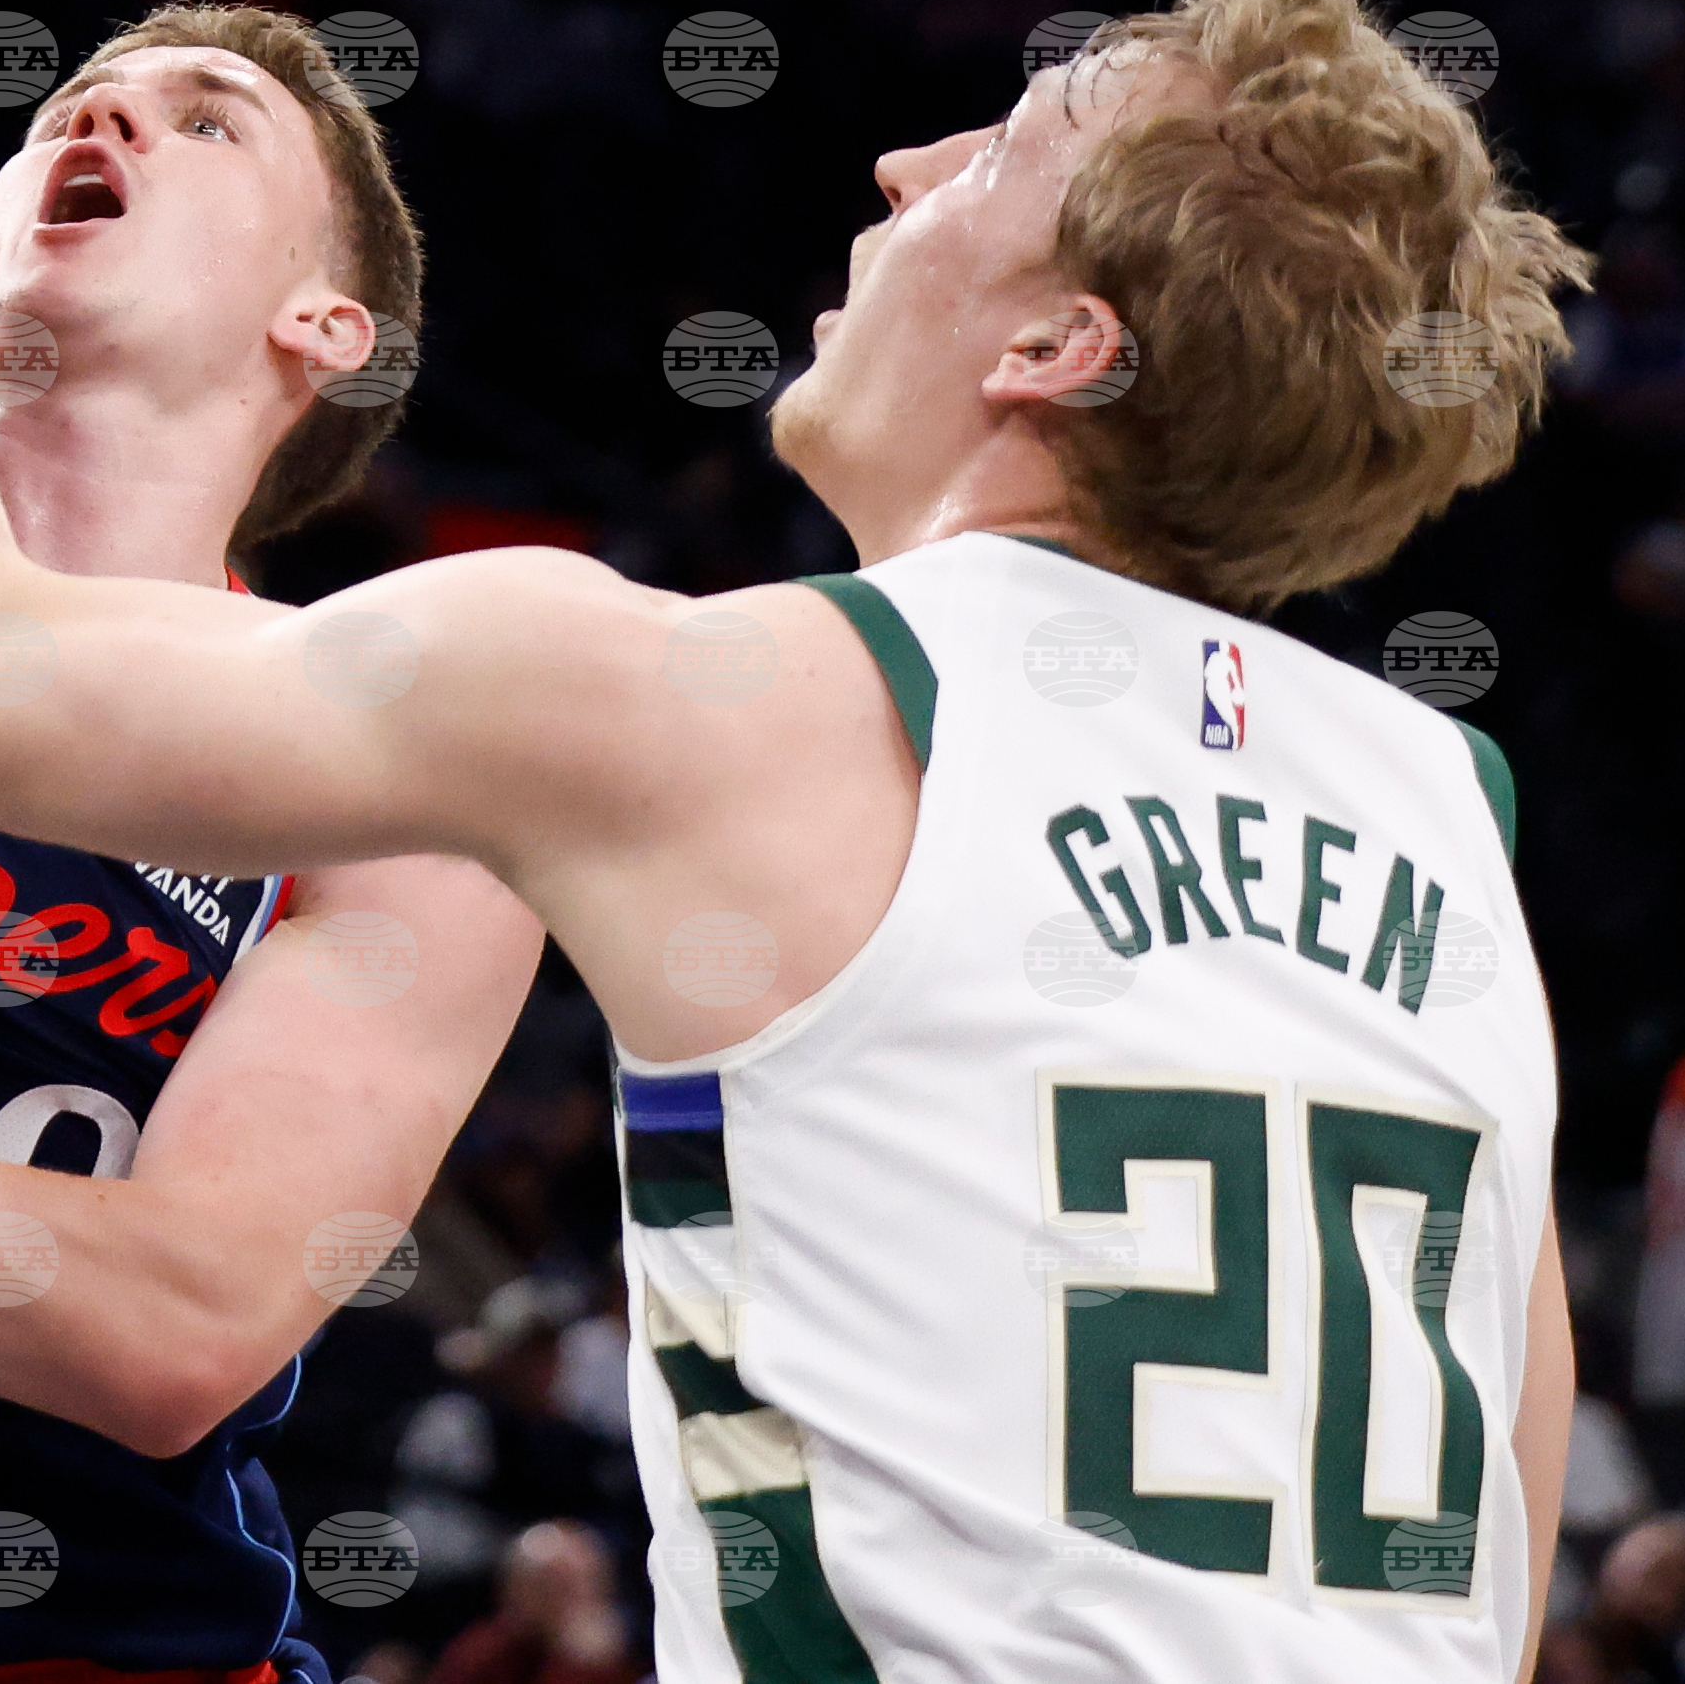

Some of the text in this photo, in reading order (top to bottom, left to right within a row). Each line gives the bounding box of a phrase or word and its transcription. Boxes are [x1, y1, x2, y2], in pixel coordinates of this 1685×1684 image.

[1204, 723, 1229, 747] NBA
[1046, 794, 1446, 1015] GREEN
[1040, 1071, 1496, 1613] 20
